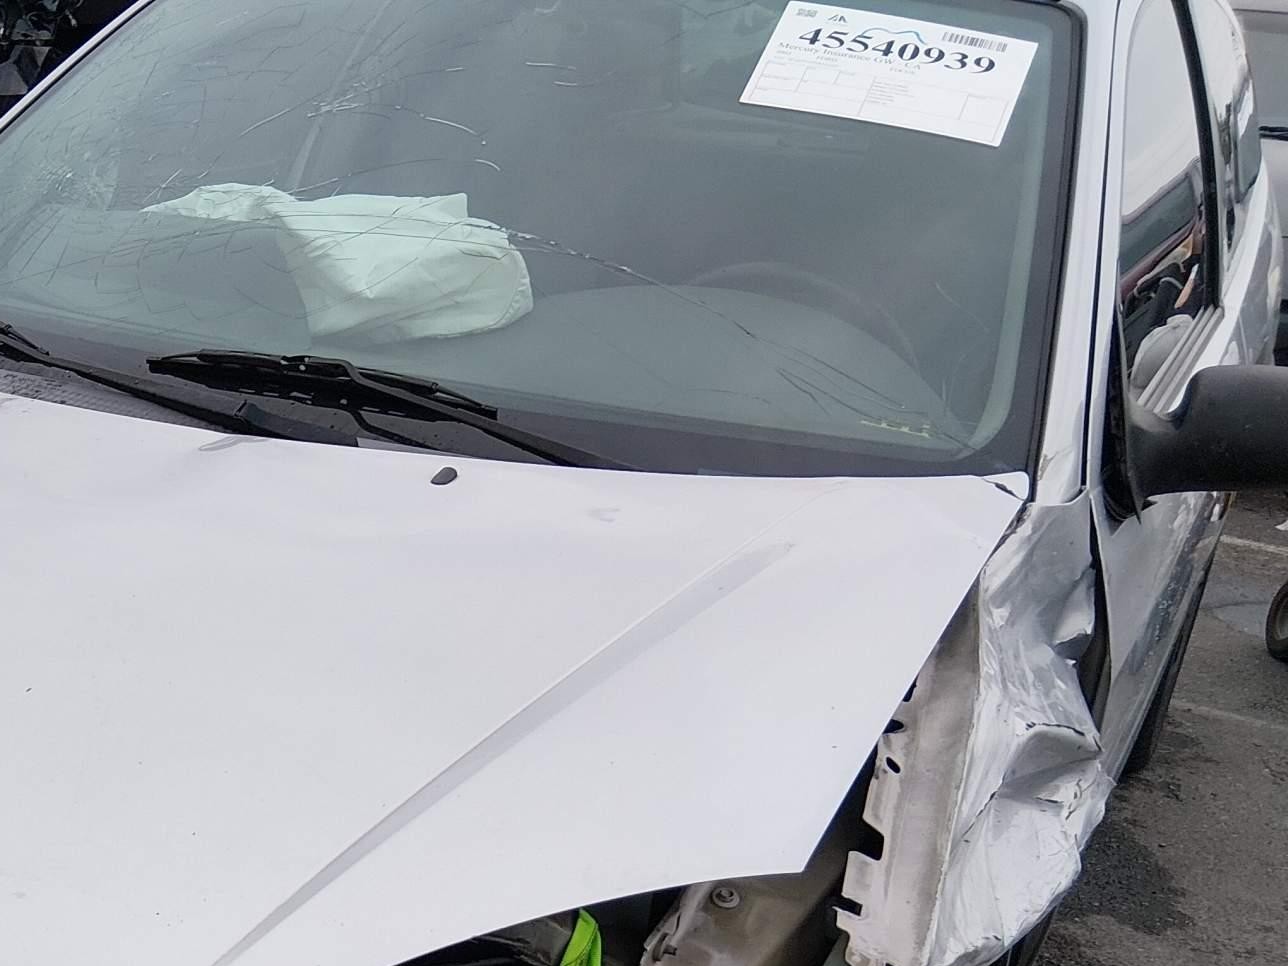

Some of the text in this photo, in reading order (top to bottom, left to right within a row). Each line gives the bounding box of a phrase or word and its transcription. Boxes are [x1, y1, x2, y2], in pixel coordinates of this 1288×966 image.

[778, 42, 818, 54] Mercury
[823, 48, 872, 62] Insurance
[799, 28, 995, 74] 45540939
